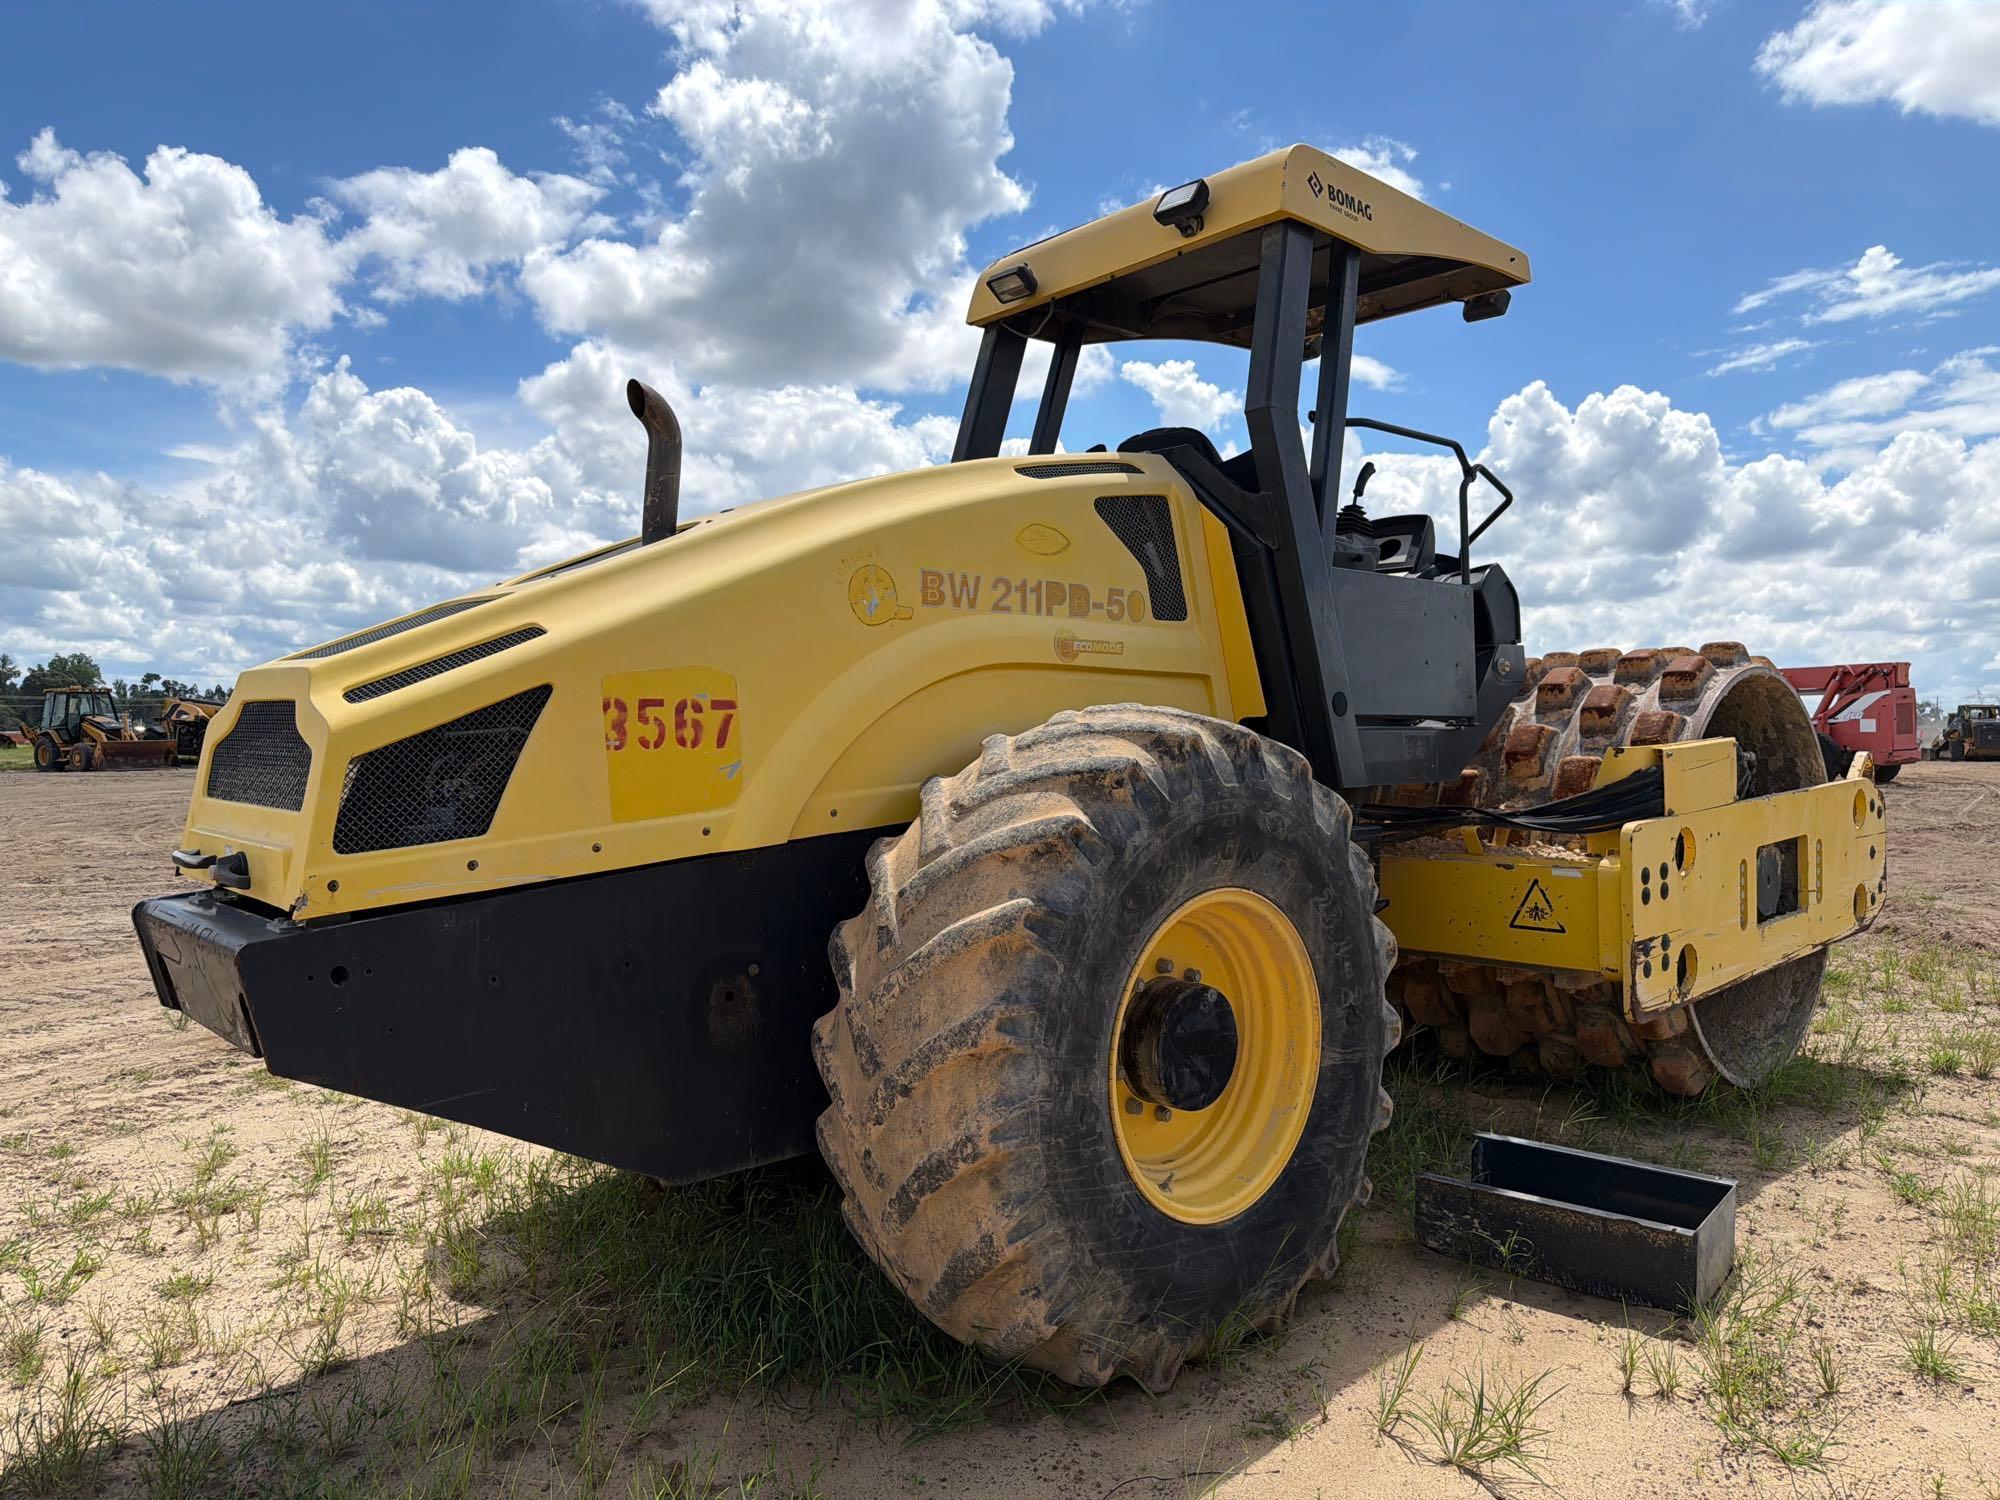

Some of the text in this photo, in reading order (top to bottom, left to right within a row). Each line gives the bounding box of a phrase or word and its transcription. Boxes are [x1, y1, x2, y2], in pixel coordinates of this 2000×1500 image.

[1327, 183, 1373, 221] BOMAG
[921, 569, 982, 610] BW
[602, 697, 738, 751] 3567
[1843, 711, 1864, 720] JLG
